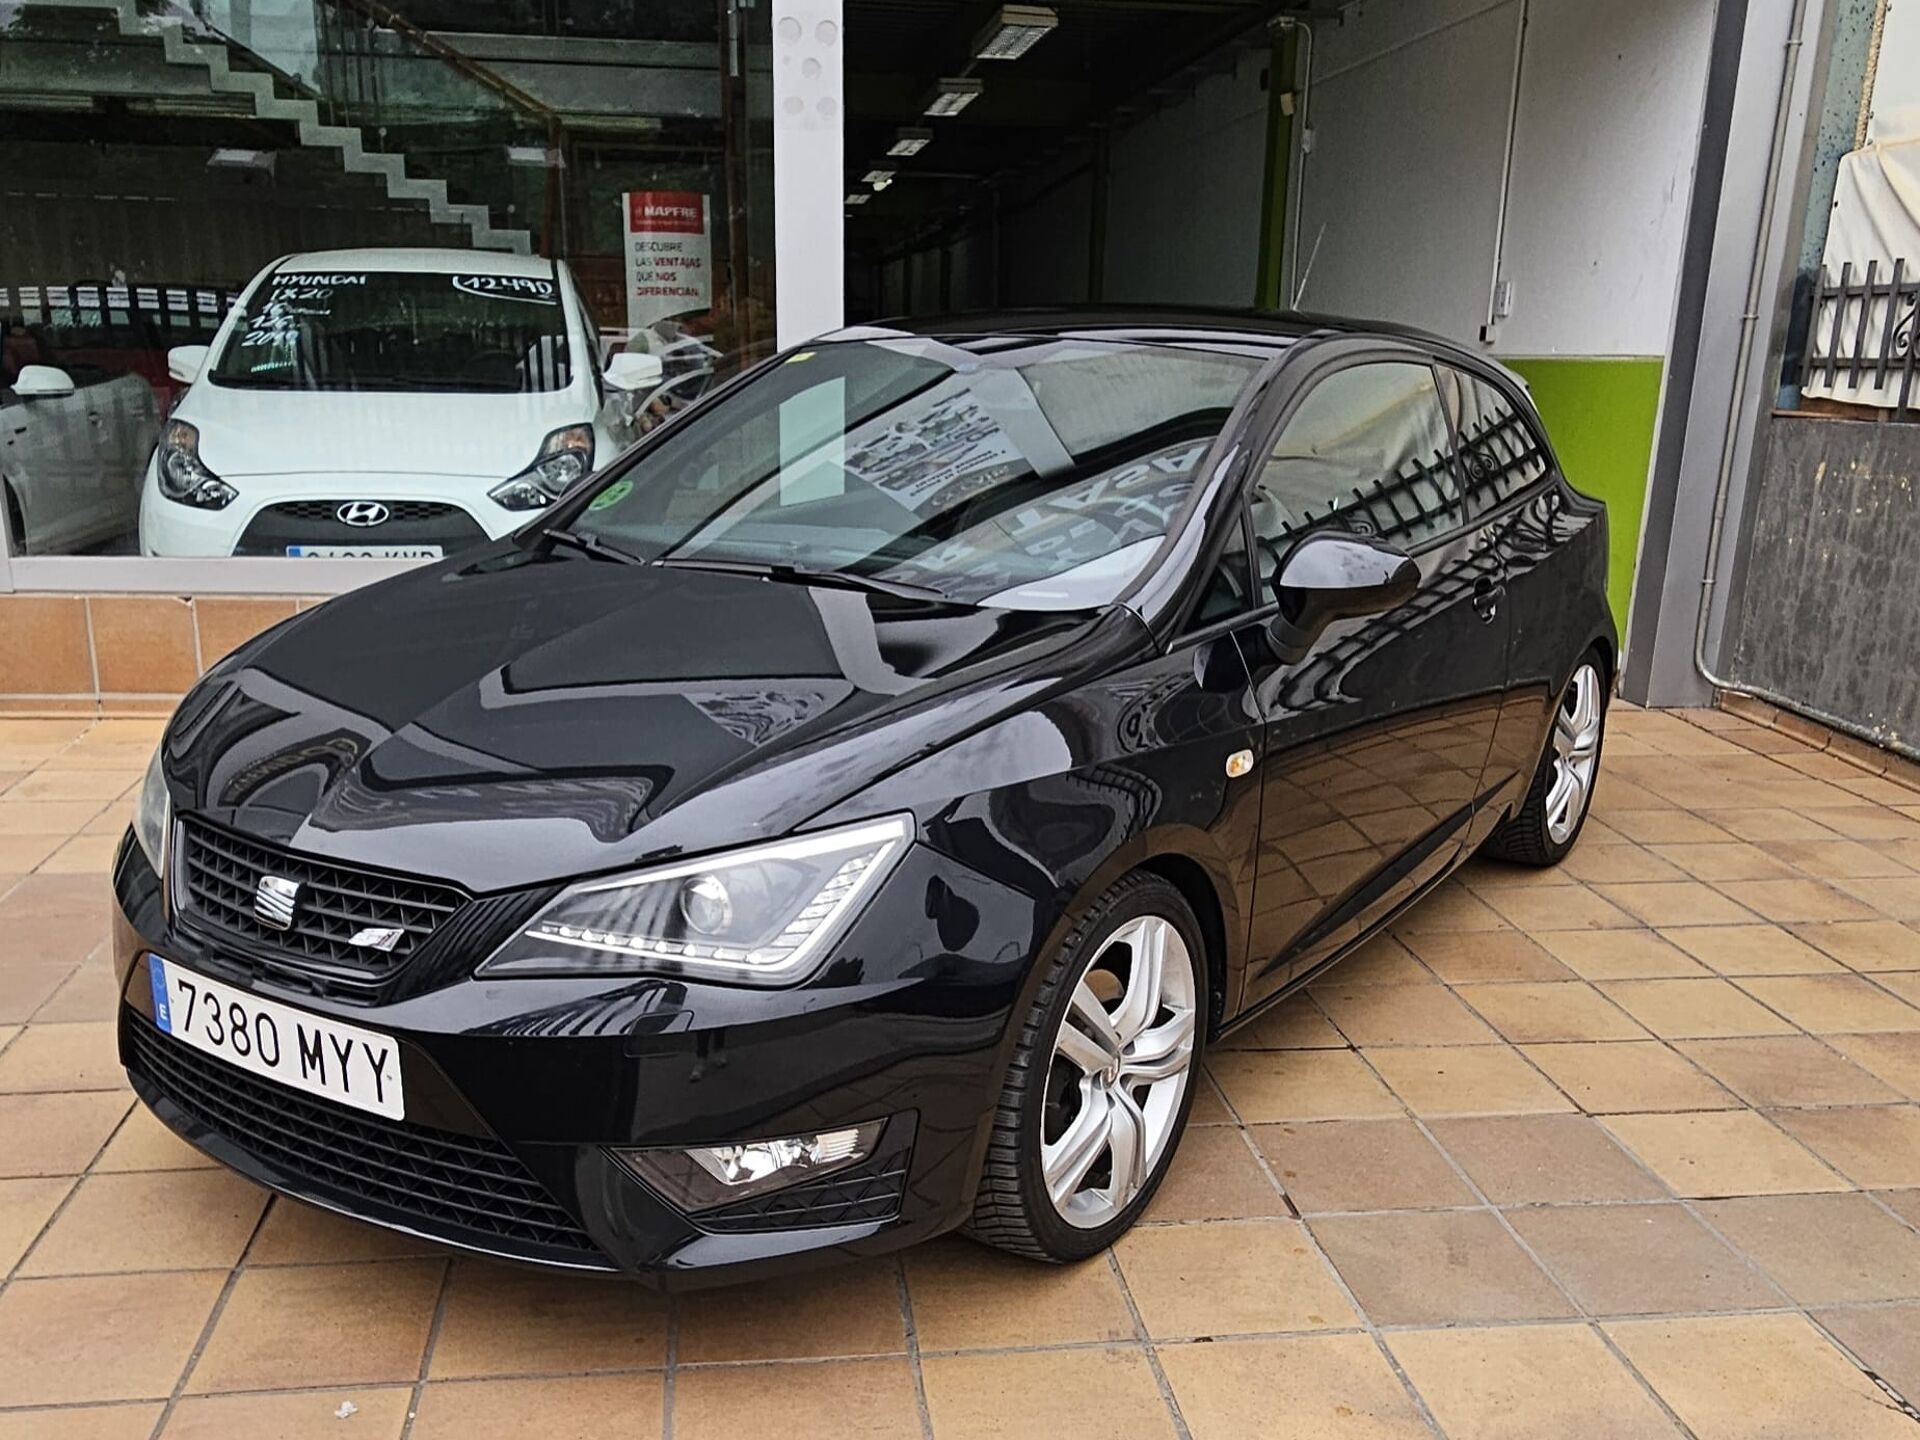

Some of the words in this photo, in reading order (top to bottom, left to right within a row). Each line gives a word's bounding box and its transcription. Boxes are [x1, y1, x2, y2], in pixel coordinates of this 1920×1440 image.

[644, 206, 697, 218] MAPFRE
[635, 241, 683, 253] DESCUBRE
[635, 257, 652, 267] LAS
[655, 257, 701, 269] VENTAJAS
[272, 274, 368, 287] HYUNDAI
[636, 272, 653, 282] QUE
[656, 272, 677, 282] NOS
[637, 286, 699, 297] DIFERENCIAN
[158, 1003, 168, 1021] E
[178, 979, 280, 1068] 7380
[297, 1023, 388, 1103] MYY
